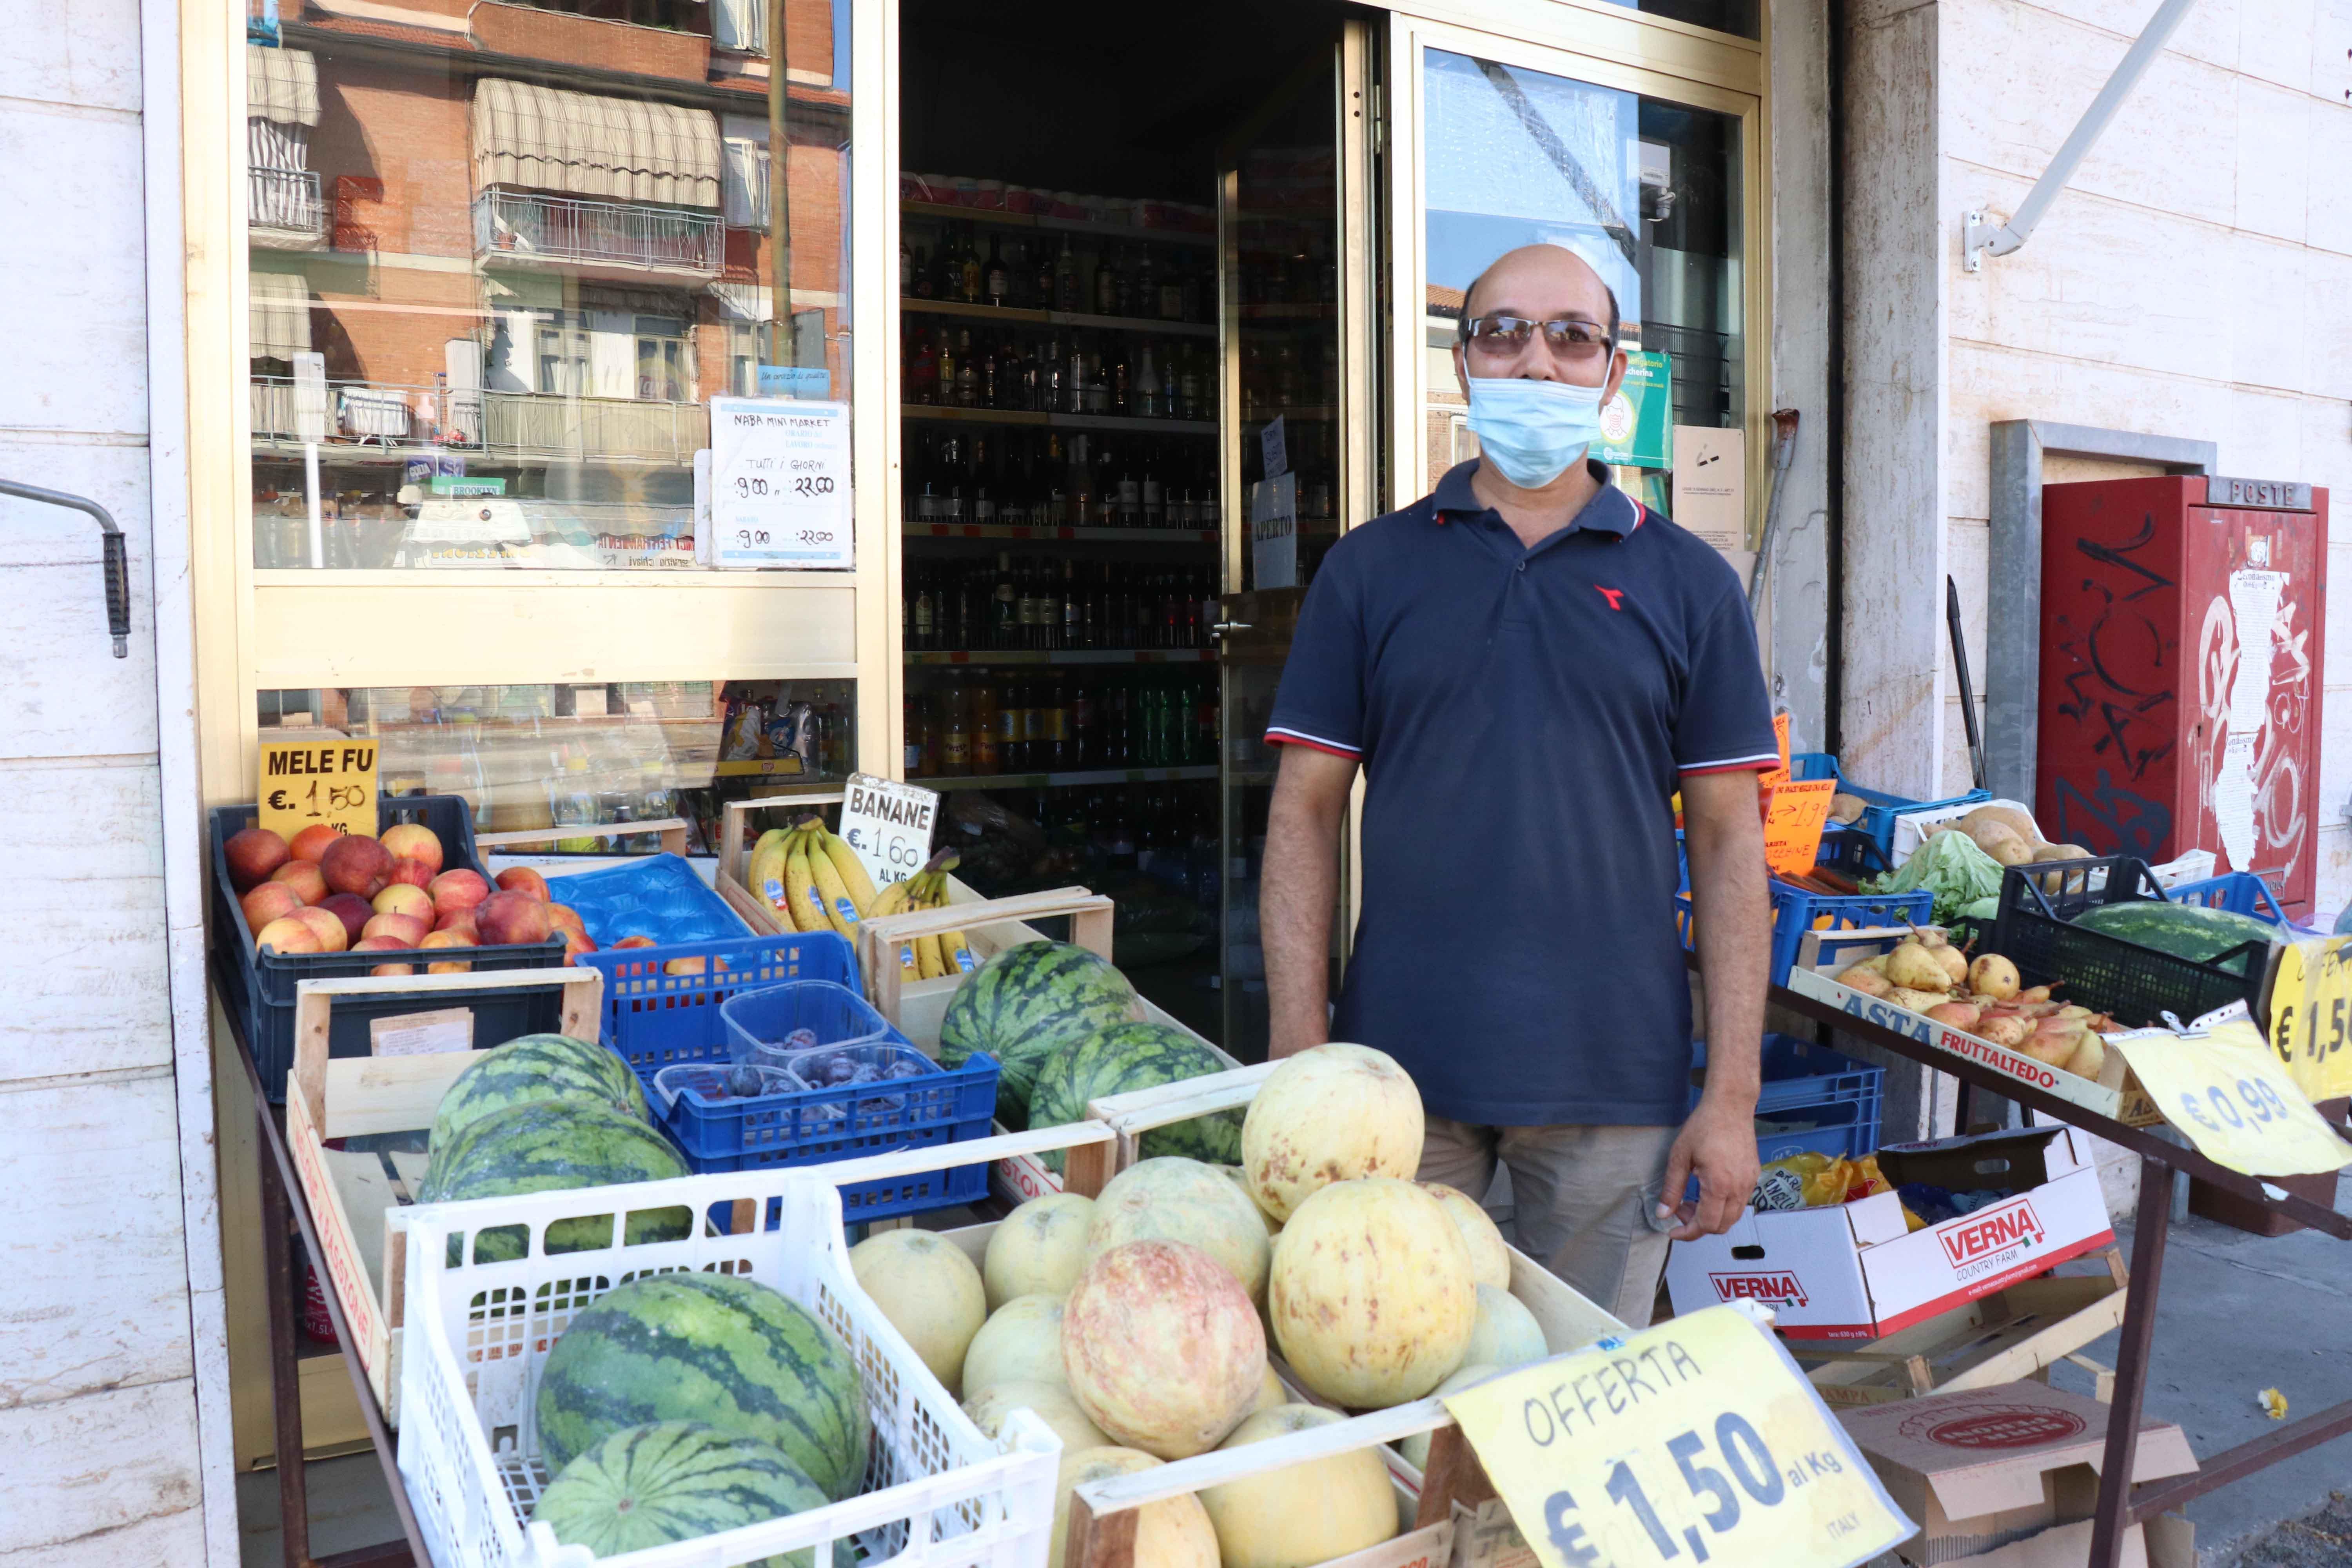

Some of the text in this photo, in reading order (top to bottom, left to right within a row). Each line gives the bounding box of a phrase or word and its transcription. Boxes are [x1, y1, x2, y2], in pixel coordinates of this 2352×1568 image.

[734, 415, 830, 427] NABA MINI MARKET
[790, 458, 826, 473] GIORNI
[454, 486, 498, 495] BROOKLYN
[2230, 480, 2294, 506] POSTE
[1255, 514, 1292, 542] APERTO
[269, 749, 373, 775] MELE FU
[850, 788, 931, 831] BANANE
[1766, 844, 1810, 860] UCCHINE
[879, 868, 891, 883] AL
[1840, 994, 1933, 1046] ASTA
[1940, 1031, 2055, 1089] FRUTTALTEDO
[2307, 998, 2352, 1064] 1,5
[1945, 1208, 2036, 1262] VERNA
[1956, 1249, 2018, 1282] COUNTRY FARM
[1715, 1277, 1800, 1298] VERNA
[1524, 1340, 1702, 1448] OFFERTA
[1604, 1411, 1786, 1564] 1,50
[1787, 1467, 1806, 1489] al
[1807, 1449, 1842, 1476] Kg
[1827, 1511, 1861, 1541] ITALY
